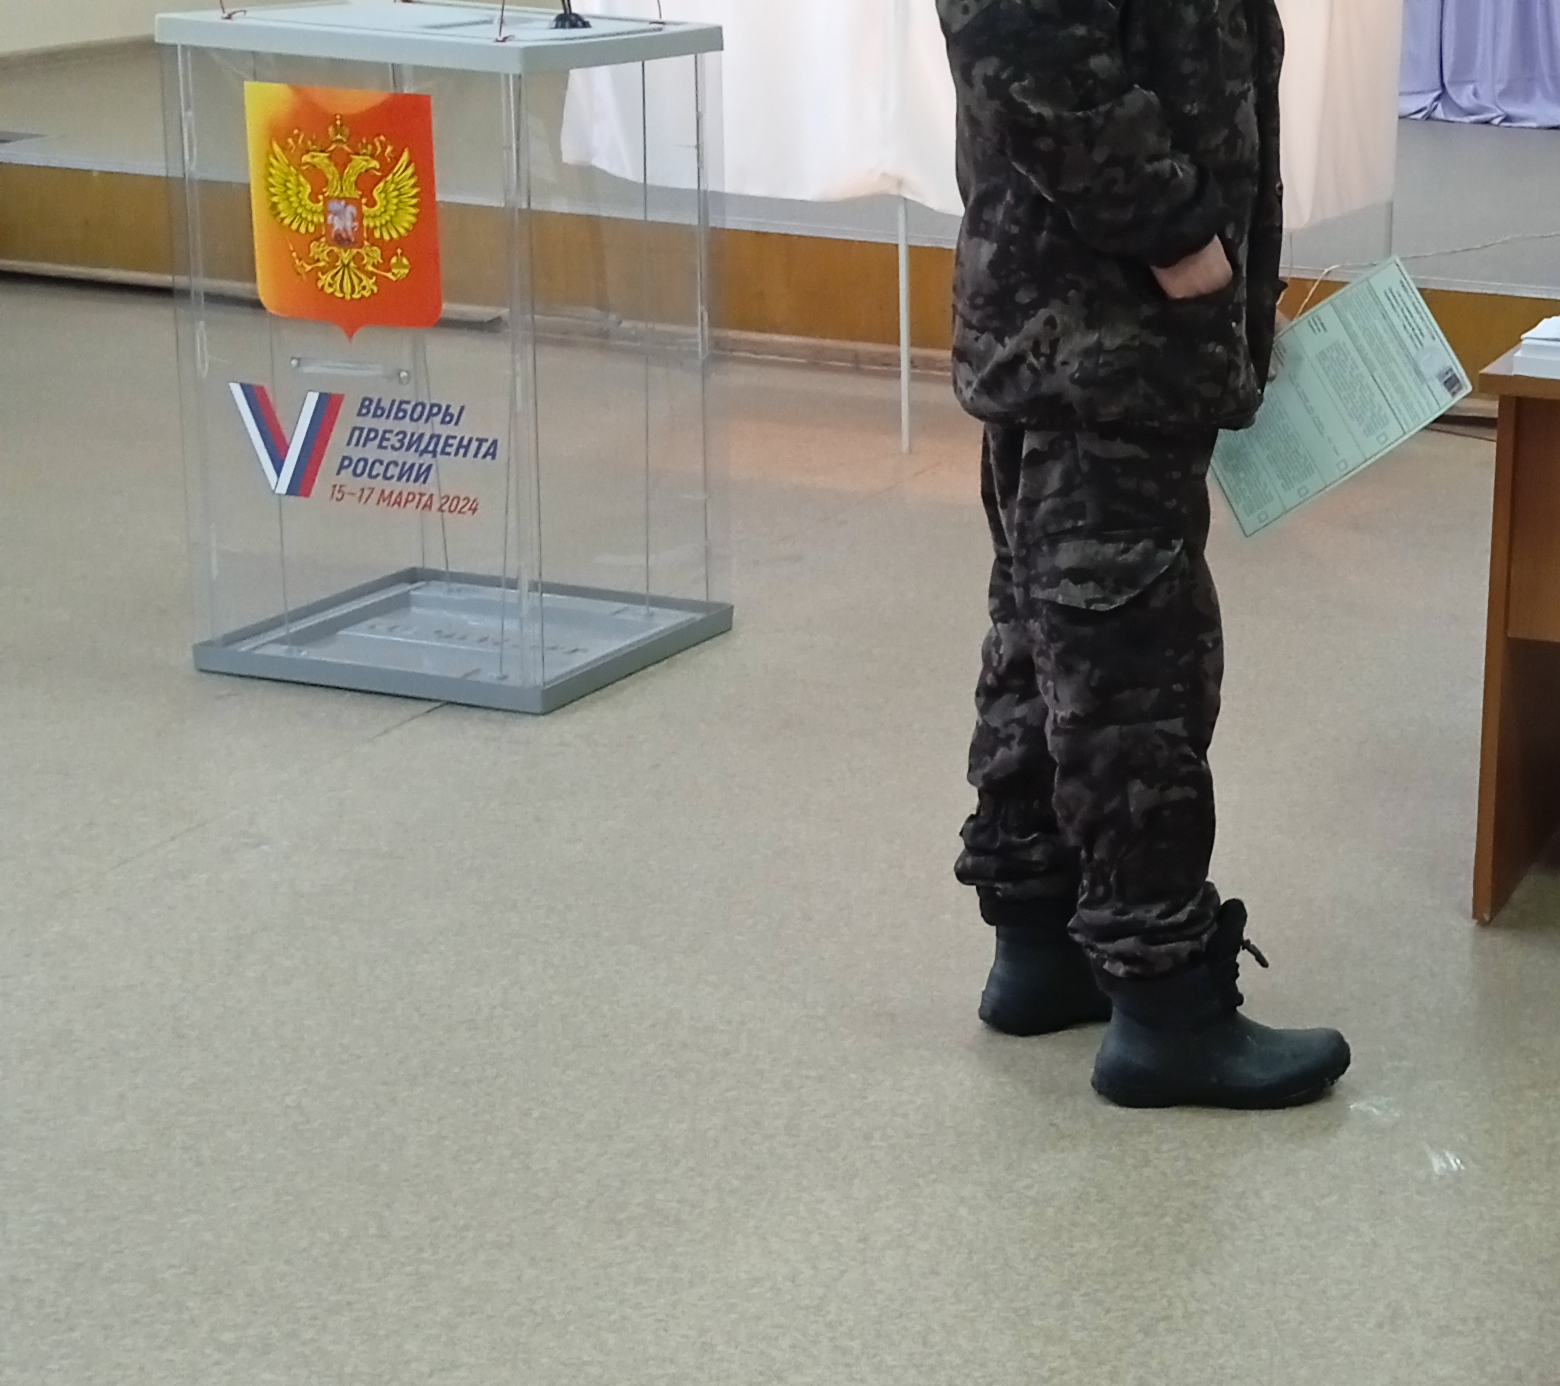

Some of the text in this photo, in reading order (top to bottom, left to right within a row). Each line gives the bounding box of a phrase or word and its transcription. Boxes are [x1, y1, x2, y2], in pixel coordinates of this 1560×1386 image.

[356, 396, 466, 427] ВЫБОРЫ
[346, 425, 499, 461] ПРЕЗИДЕНТА
[335, 455, 433, 485] РОССИИ
[375, 489, 434, 512] МАРТА
[436, 494, 480, 516] 2024
